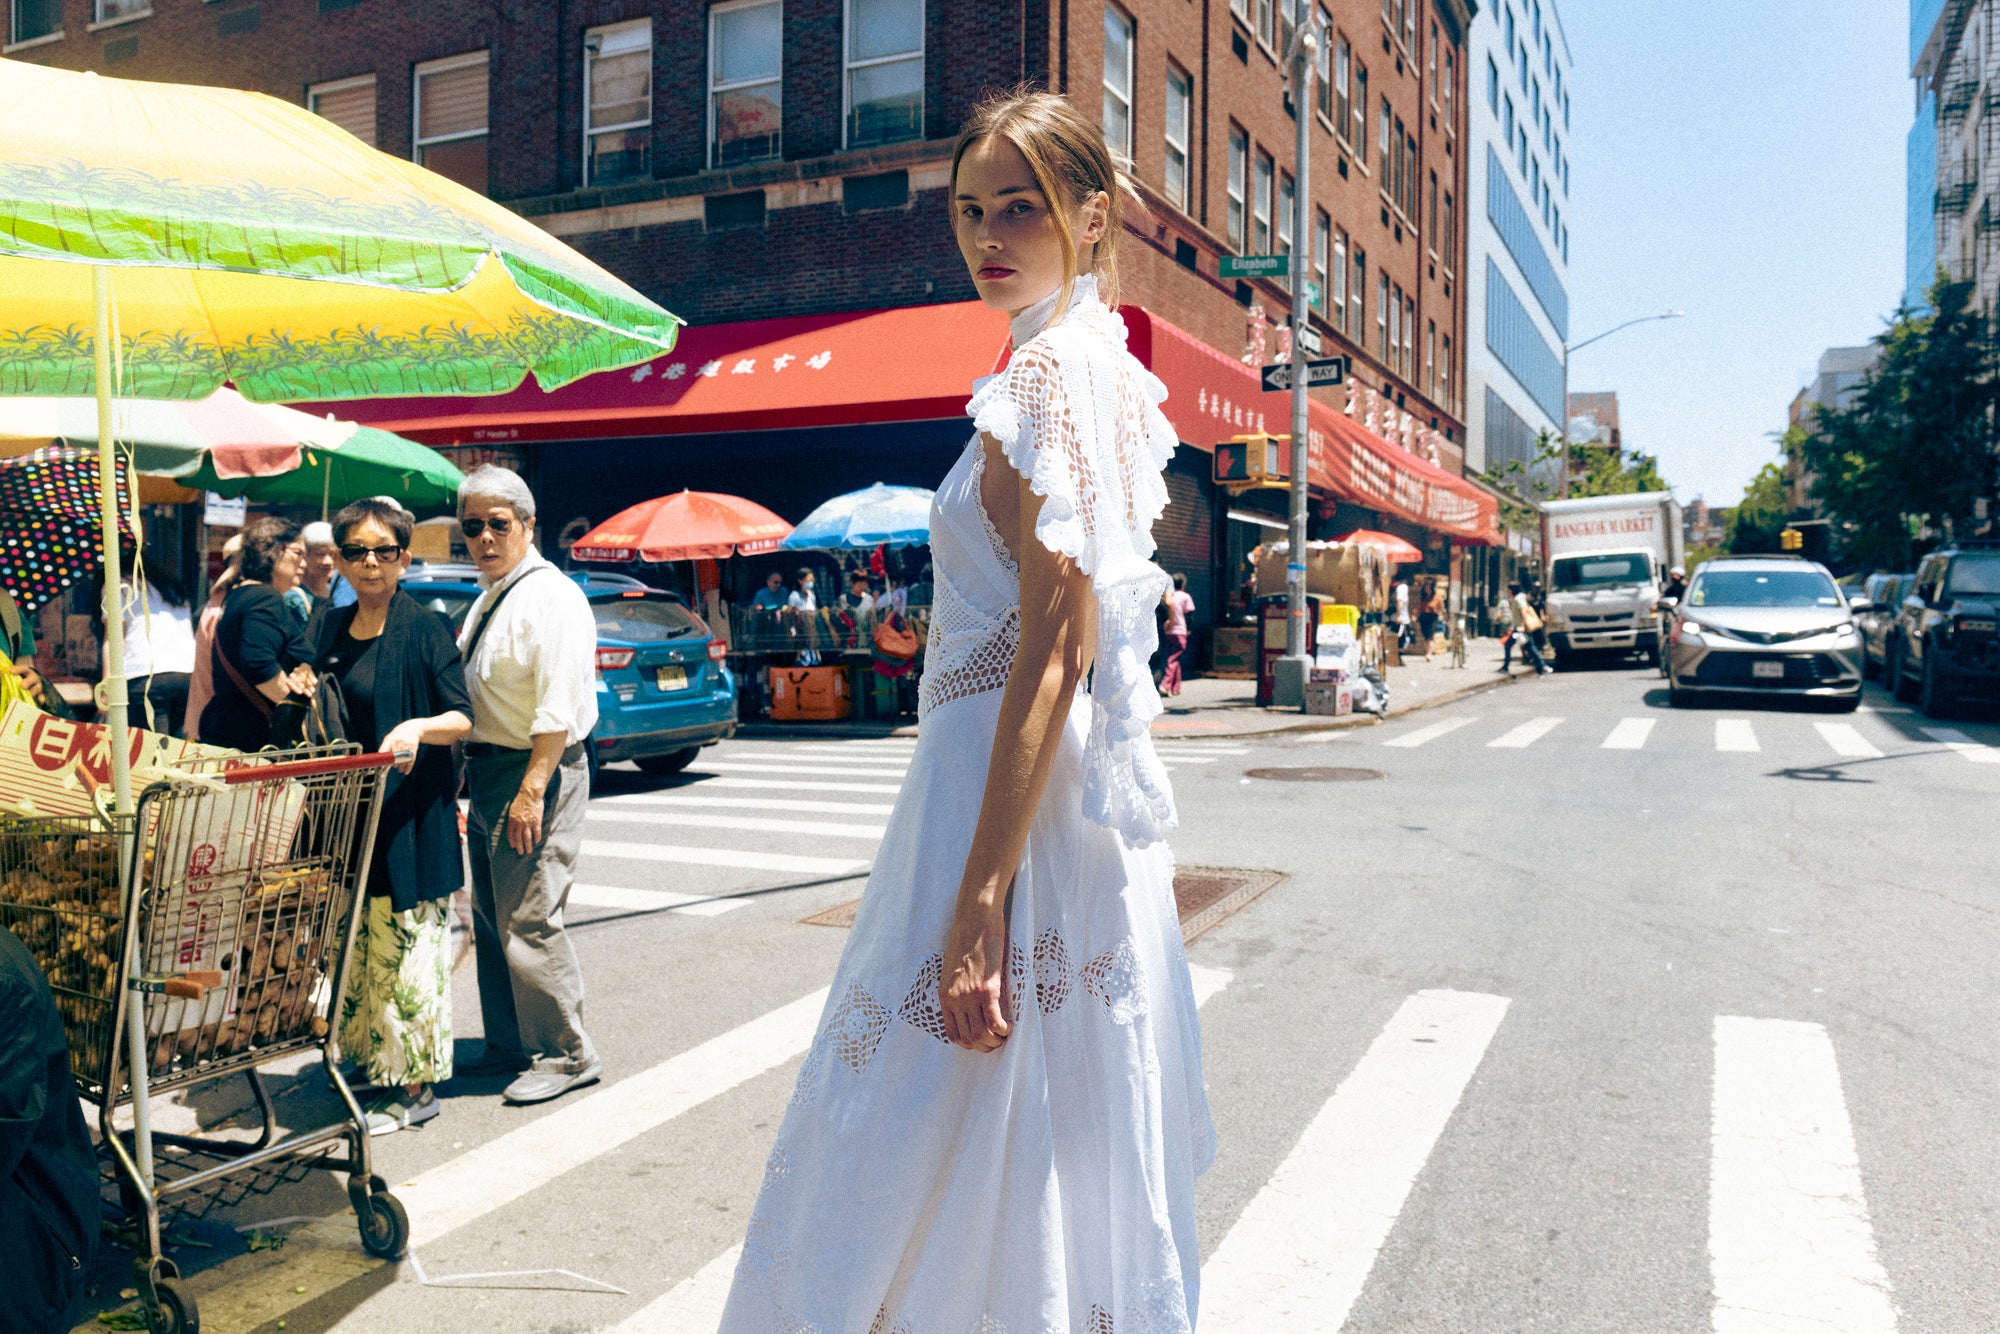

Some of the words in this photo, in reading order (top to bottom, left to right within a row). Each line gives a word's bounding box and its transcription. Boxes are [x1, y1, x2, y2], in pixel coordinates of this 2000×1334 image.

[1231, 258, 1278, 270] Elizabeth
[1311, 367, 1333, 378] WAY
[1609, 517, 1654, 533] MARKET
